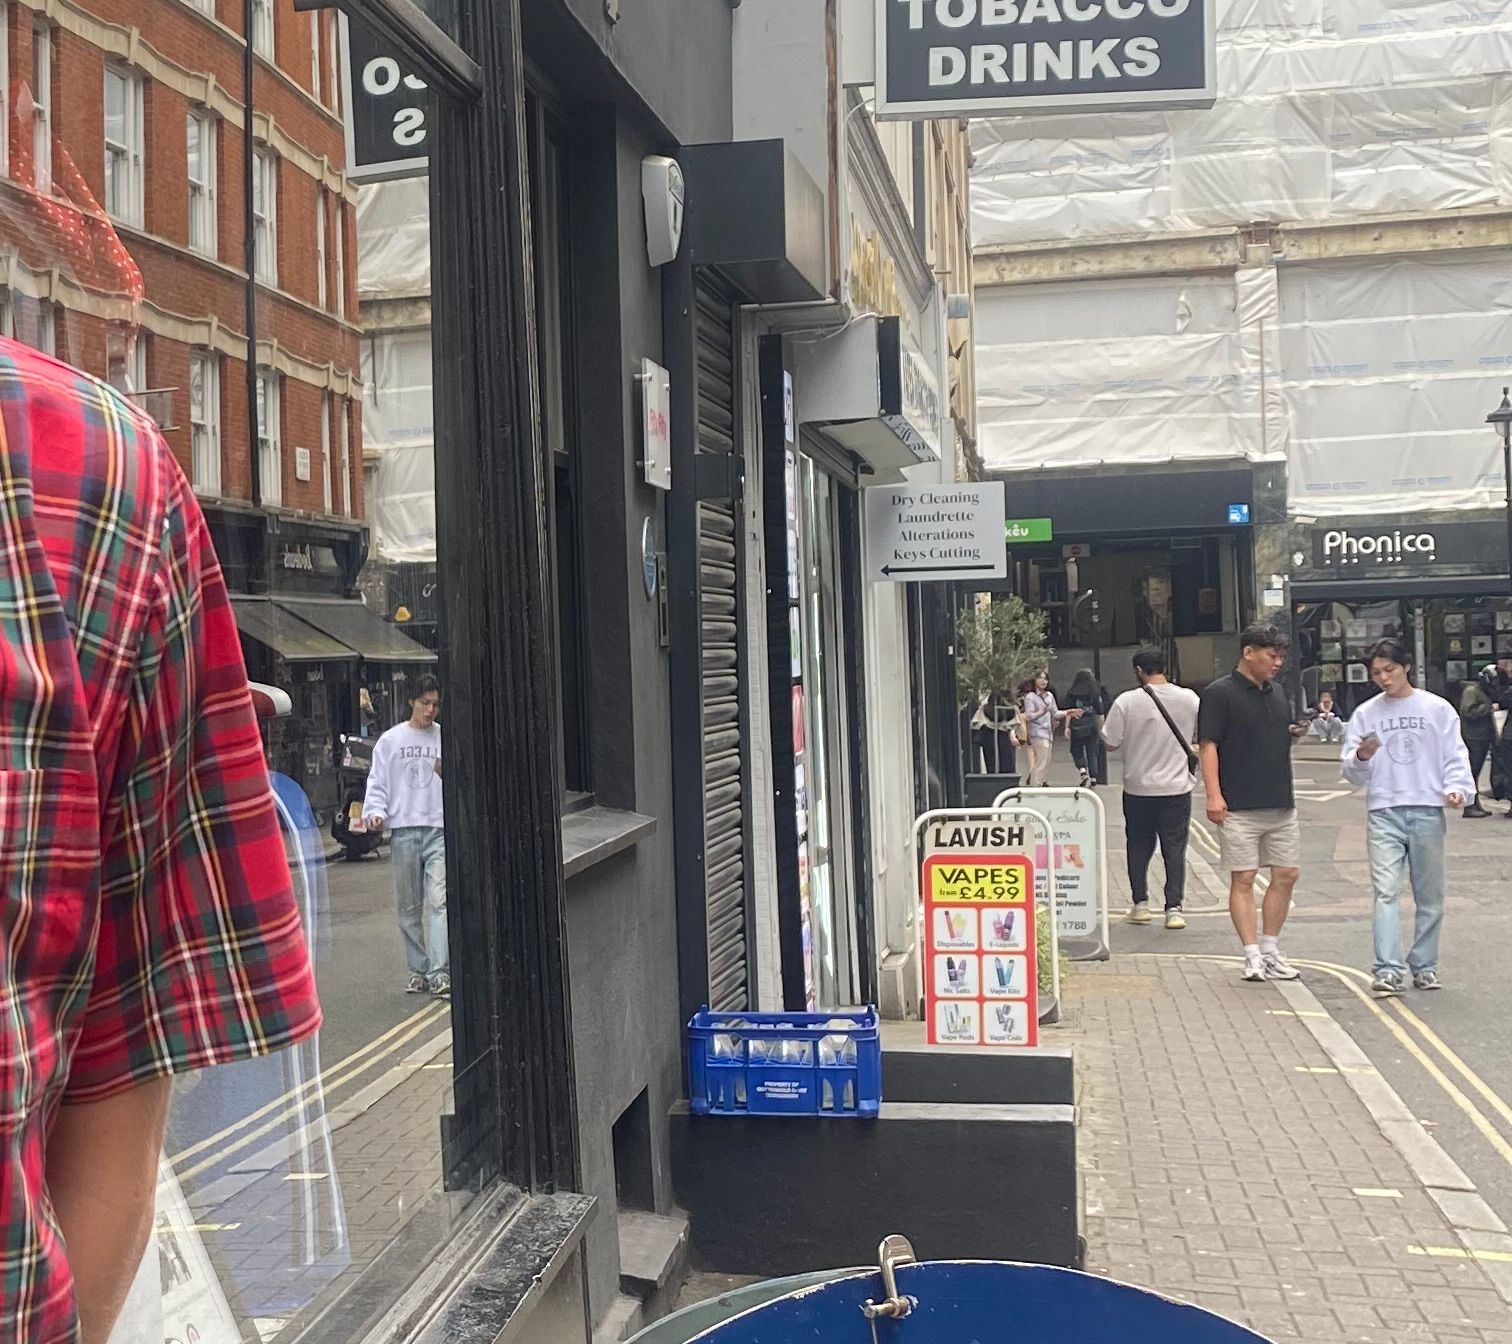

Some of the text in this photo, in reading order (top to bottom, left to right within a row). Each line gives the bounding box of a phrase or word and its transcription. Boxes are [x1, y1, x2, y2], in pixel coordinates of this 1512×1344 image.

[928, 36, 1161, 86] DRINKS
[892, 491, 980, 508] Dry Cleaning
[898, 511, 975, 524] Laundrette
[899, 528, 975, 542] Alterations
[1324, 530, 1436, 556] Phonica
[894, 546, 981, 562] Keys Cutting
[934, 826, 1025, 847] LAVISH
[938, 868, 1019, 884] VAPES
[959, 886, 1020, 900] £4.99
